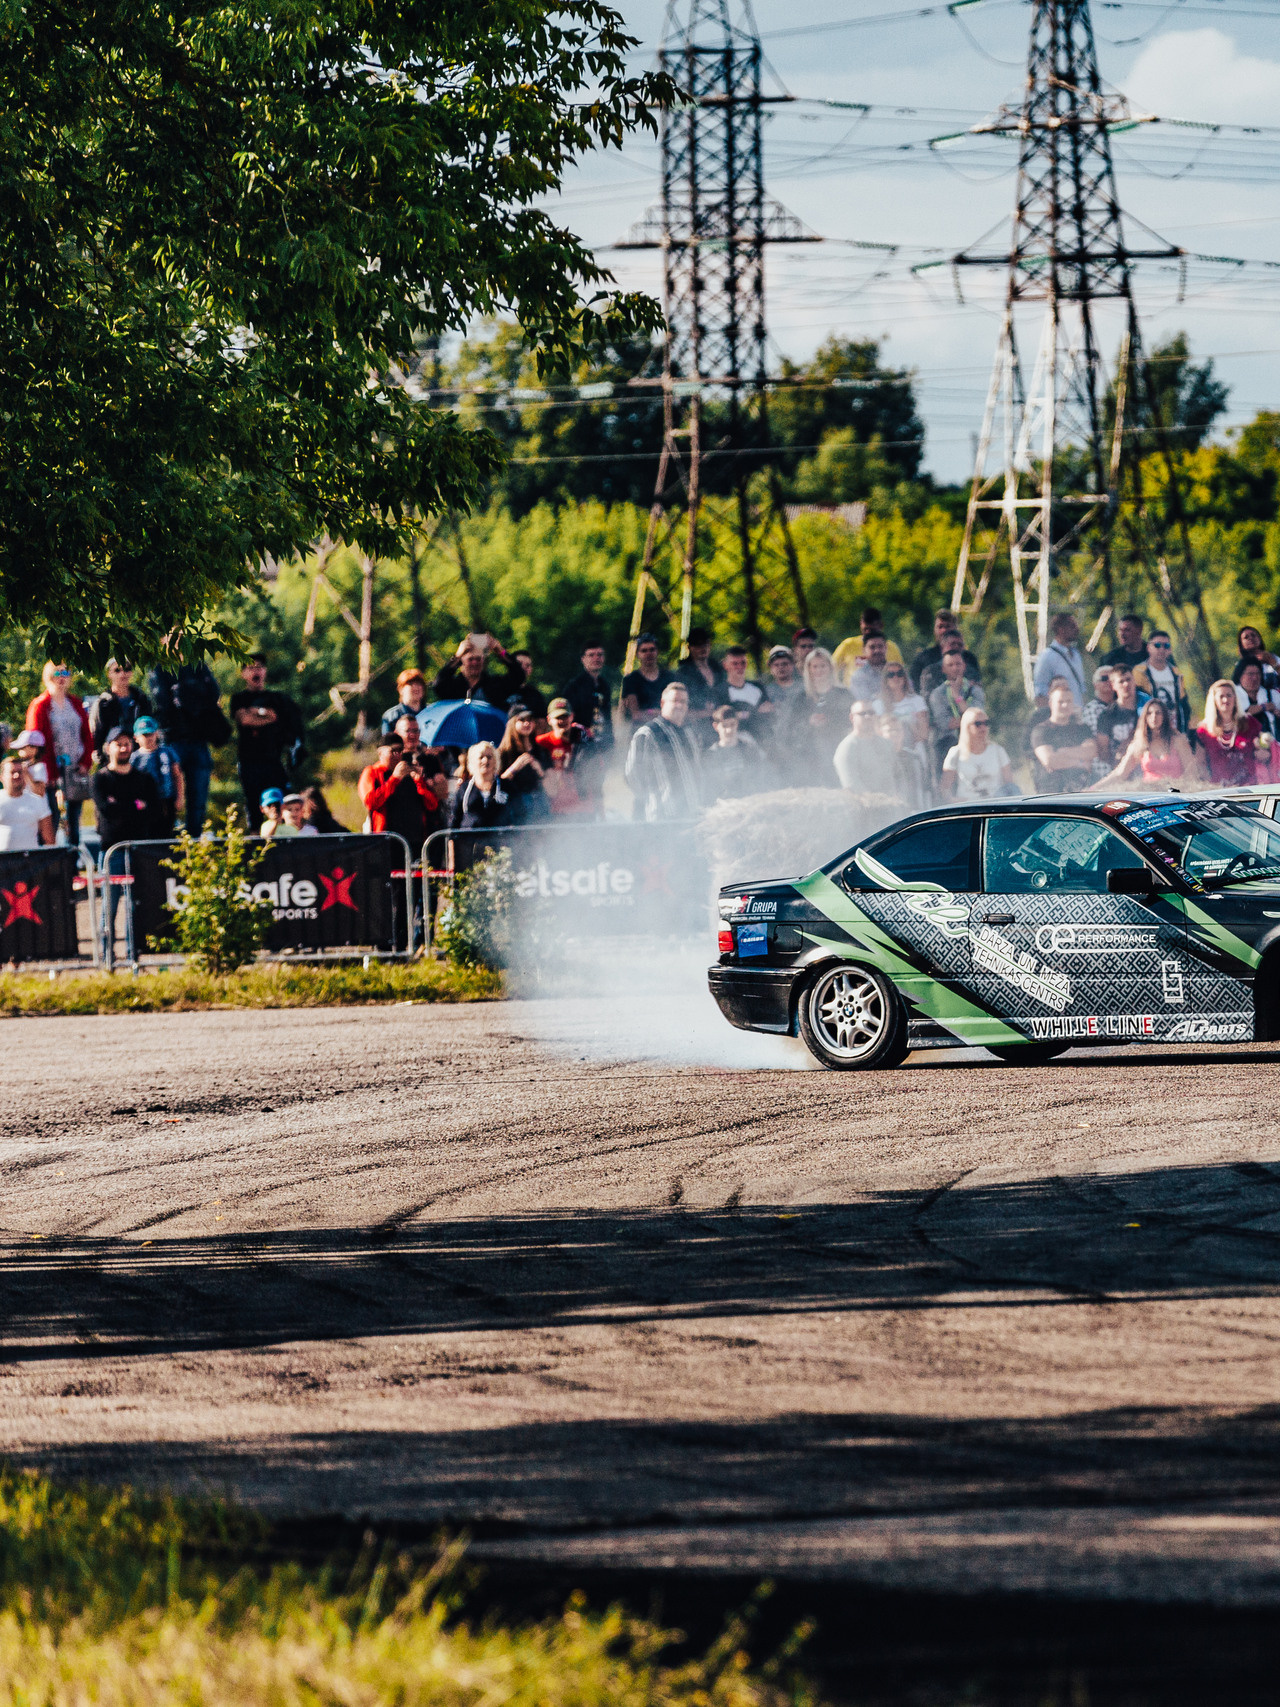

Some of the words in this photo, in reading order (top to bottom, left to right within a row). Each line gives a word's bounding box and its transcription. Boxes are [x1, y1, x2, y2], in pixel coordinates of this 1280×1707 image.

[165, 872, 319, 911] bsafe
[271, 908, 319, 921] SPORTS
[752, 901, 777, 913] GRUPA
[1078, 934, 1157, 943] PERFORMANCE
[980, 927, 1015, 960] DĀRZA
[1019, 952, 1037, 972] UN
[1040, 965, 1070, 995] MEŽA
[973, 944, 1023, 985] TEHNIKAS
[1022, 976, 1066, 1011] CENTRS
[1105, 1014, 1154, 1036] LINE
